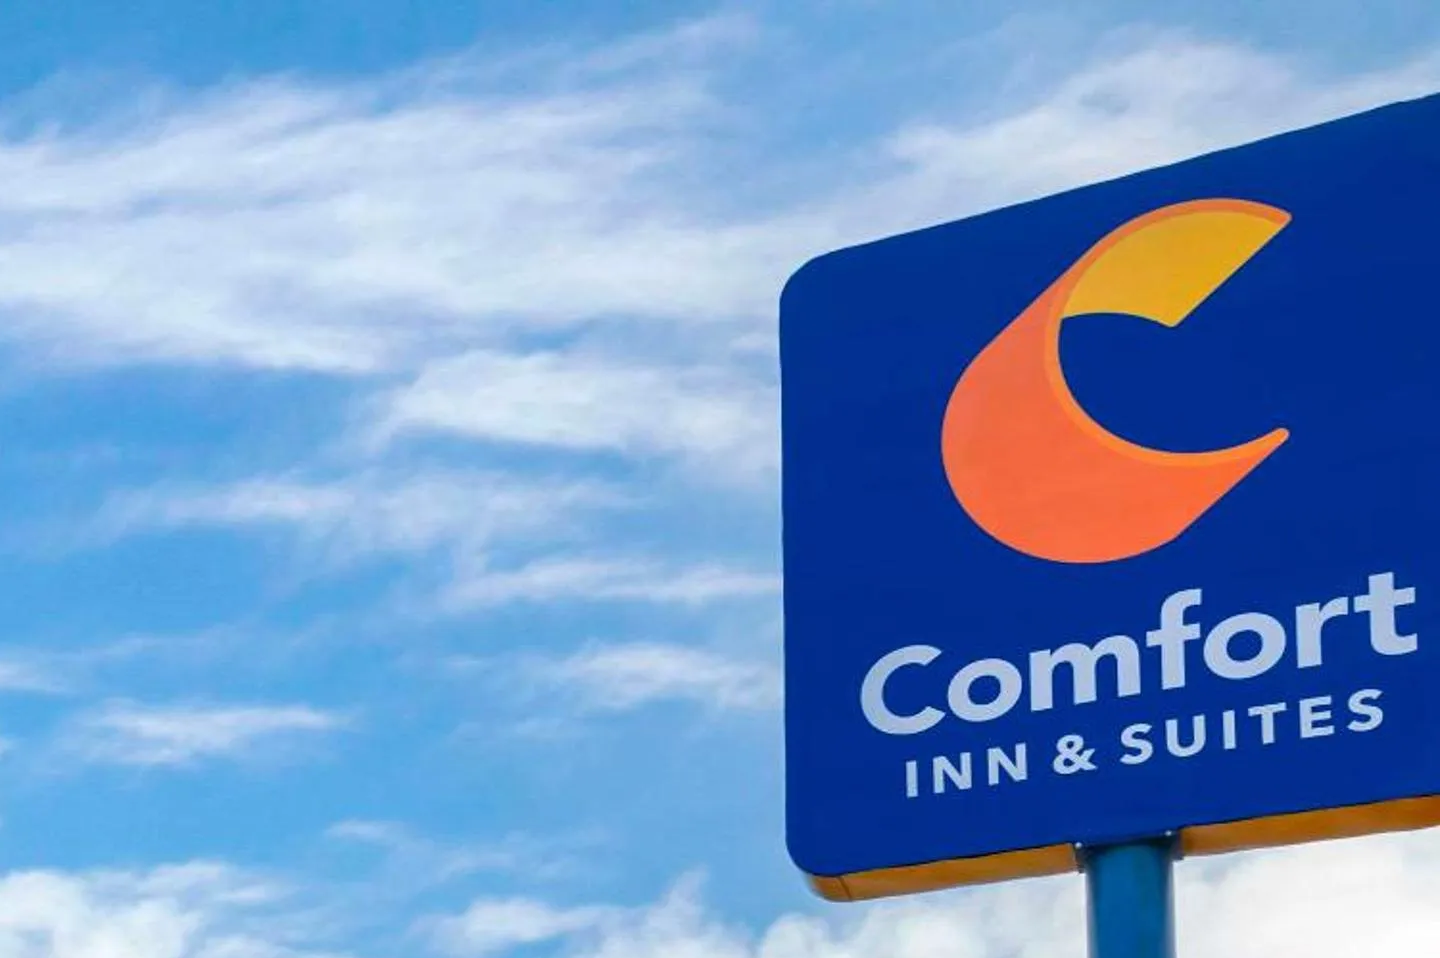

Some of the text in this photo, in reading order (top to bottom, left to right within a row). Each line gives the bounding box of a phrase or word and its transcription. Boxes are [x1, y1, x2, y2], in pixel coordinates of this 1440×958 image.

[861, 571, 1419, 735] Comfort
[905, 688, 1384, 798] INN & SUITES
